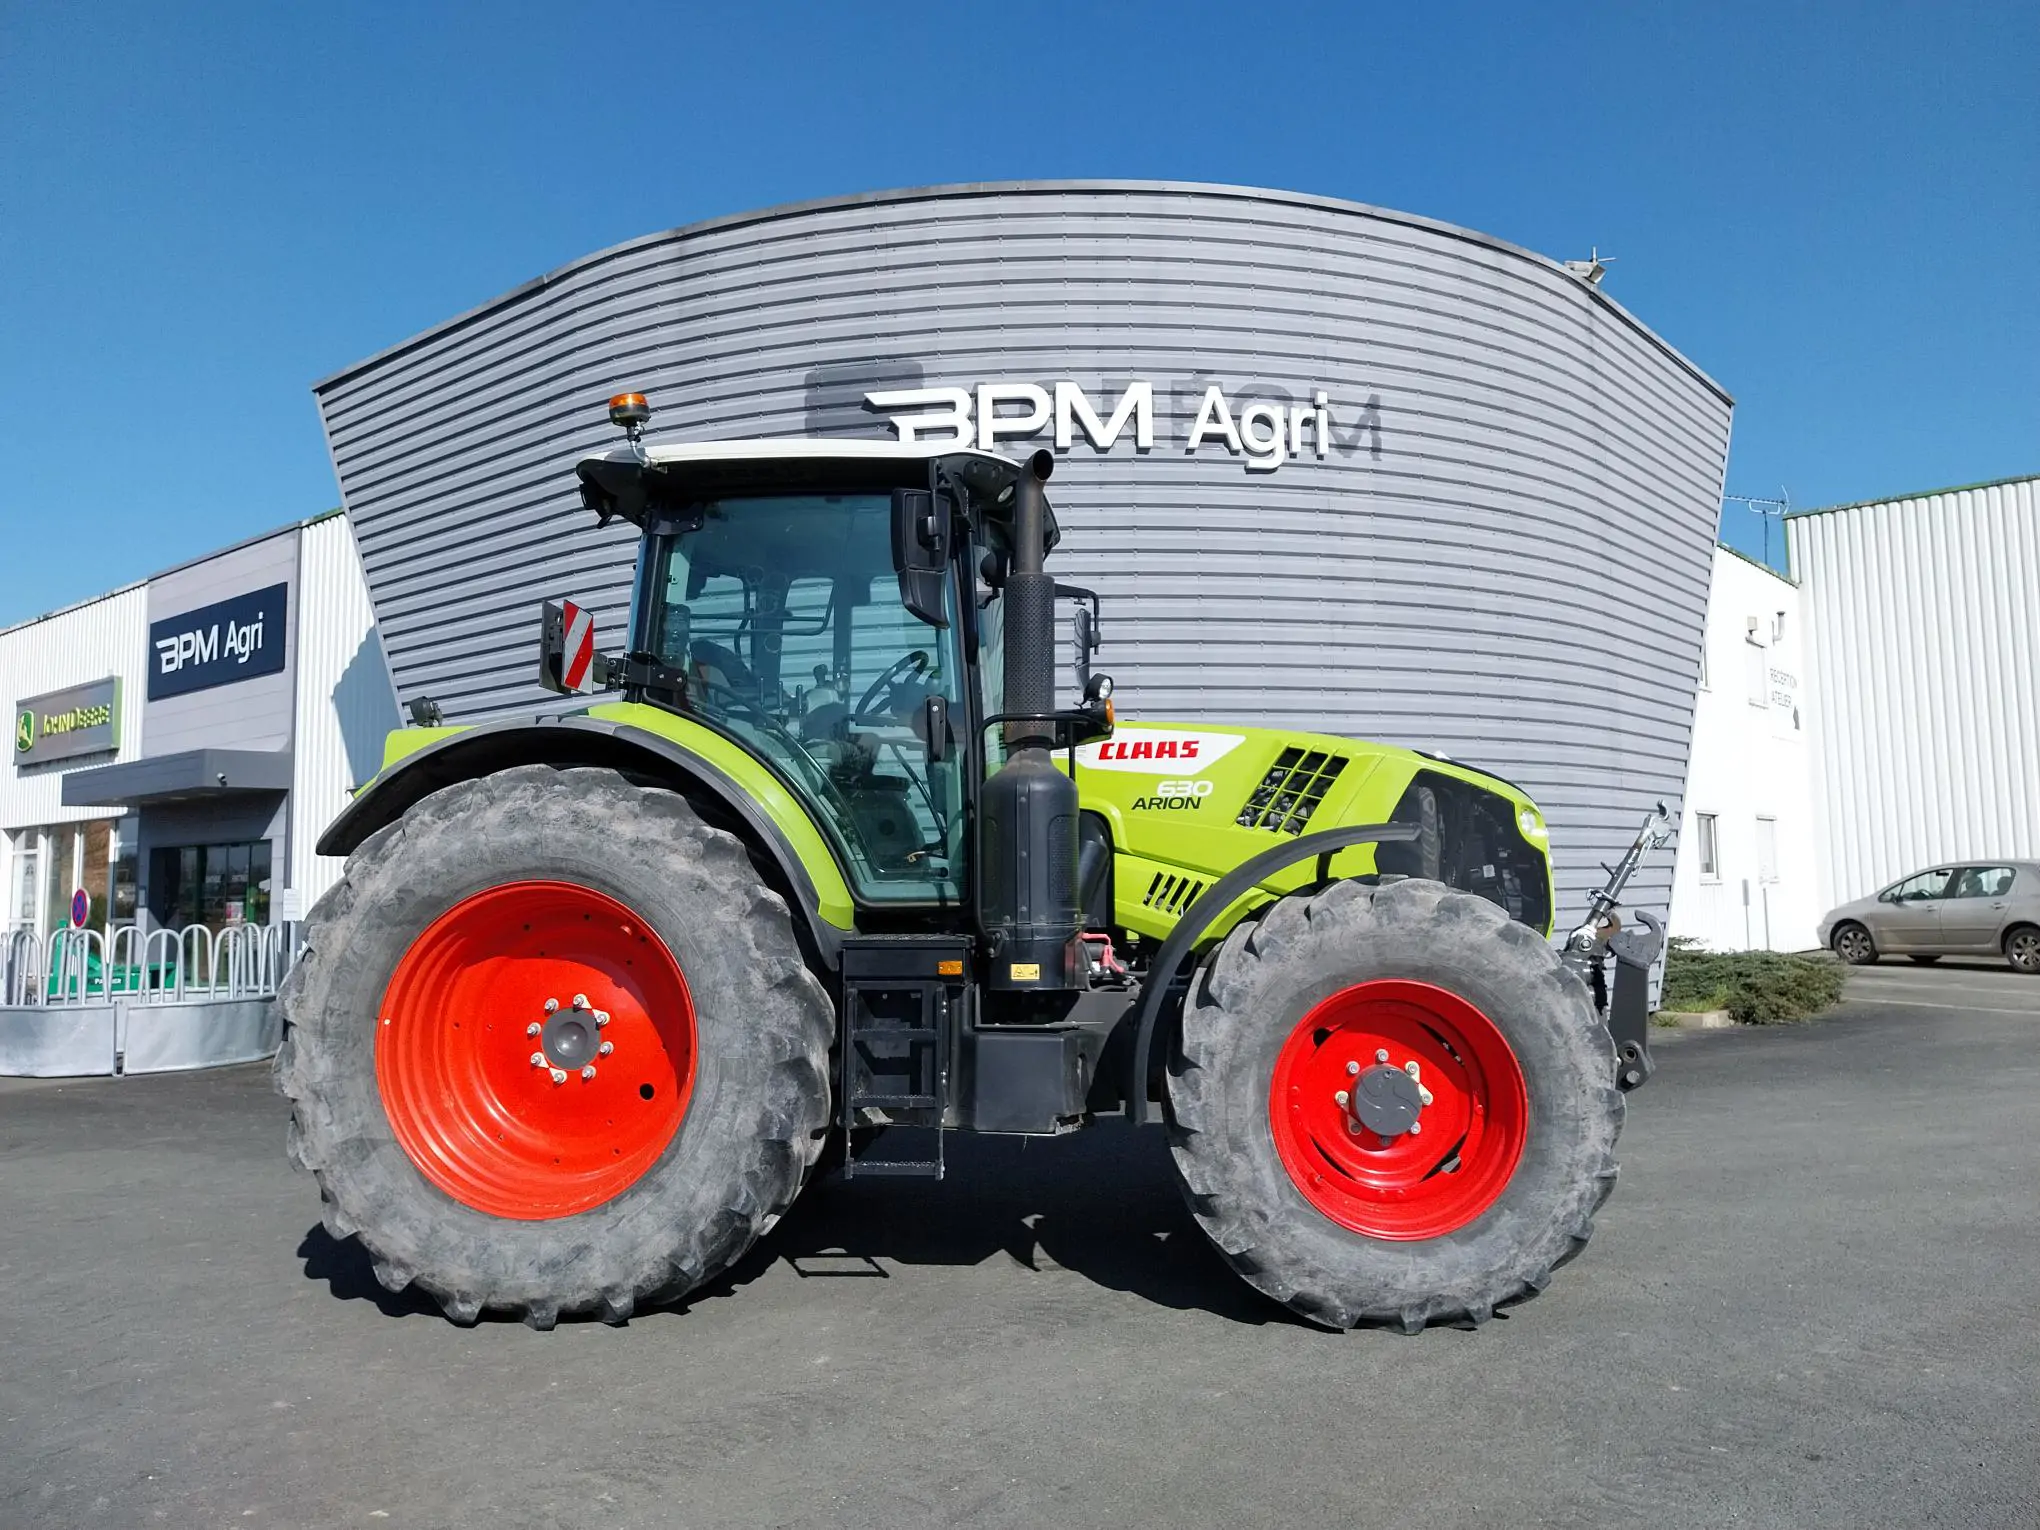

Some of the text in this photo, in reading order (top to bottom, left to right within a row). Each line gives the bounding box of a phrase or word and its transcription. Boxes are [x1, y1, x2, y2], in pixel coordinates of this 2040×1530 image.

[864, 382, 1153, 450] BPM
[1186, 386, 1329, 469] Agri
[156, 611, 264, 674] BPM Agri
[1098, 740, 1200, 760] CLAAS
[1156, 780, 1214, 797] 630
[1131, 796, 1202, 810] ARION
